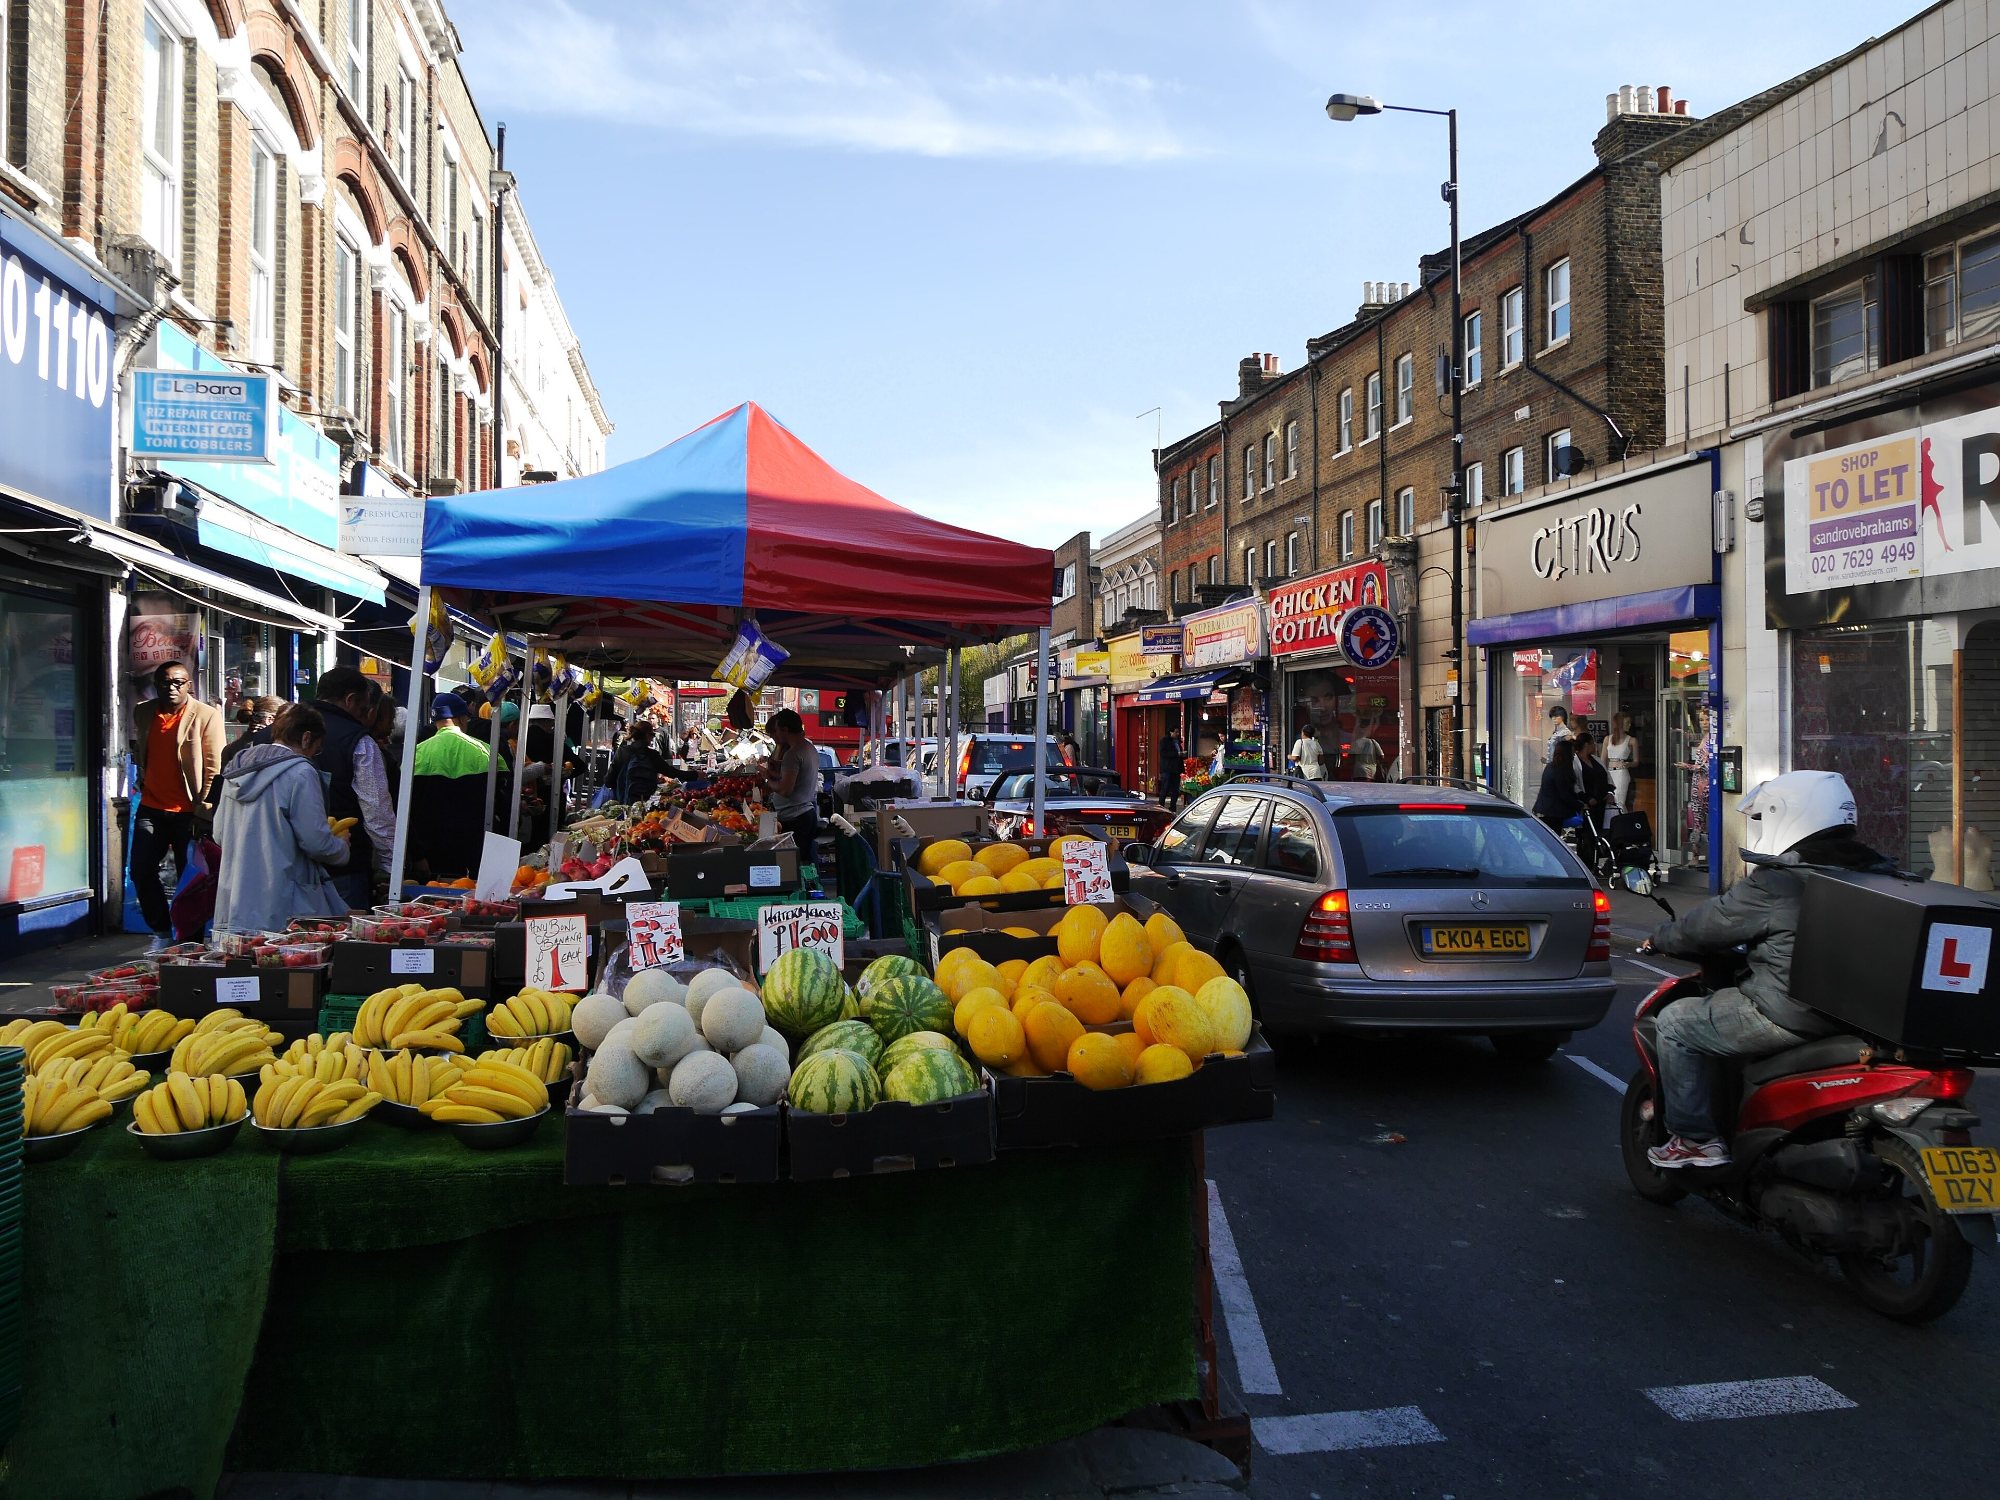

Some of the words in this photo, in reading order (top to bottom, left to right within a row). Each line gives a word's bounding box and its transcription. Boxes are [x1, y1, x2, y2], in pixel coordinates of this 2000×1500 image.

[34, 276, 108, 408] 1110
[174, 380, 242, 396] Lebara
[146, 407, 165, 418] RIZ
[168, 408, 207, 420] REPAIR
[210, 410, 253, 422] CENTRE
[150, 422, 214, 434] INTERNET
[217, 425, 249, 436] CAFE
[144, 437, 177, 448] TONI
[181, 439, 253, 451] COBBLERS
[1841, 451, 1879, 473] SHOP
[1815, 478, 1849, 512] TO
[1858, 464, 1909, 504] LET
[1531, 503, 1642, 581] CITRUS
[1815, 517, 1909, 546] sandrovebrahams
[1811, 554, 1835, 574] 020
[1842, 548, 1873, 570] 7629
[1880, 541, 1915, 563] 4949
[1270, 576, 1355, 620] CHICKEN
[1271, 609, 1346, 645] COTTAG
[1587, 722, 1607, 731] OTE
[1435, 930, 1486, 949] CK04
[1490, 930, 1527, 949] EGC
[1939, 938, 1971, 979] L
[1808, 1077, 1865, 1090] VISION
[1927, 1151, 1997, 1175] LD63
[1944, 1178, 1994, 1203] DZY
